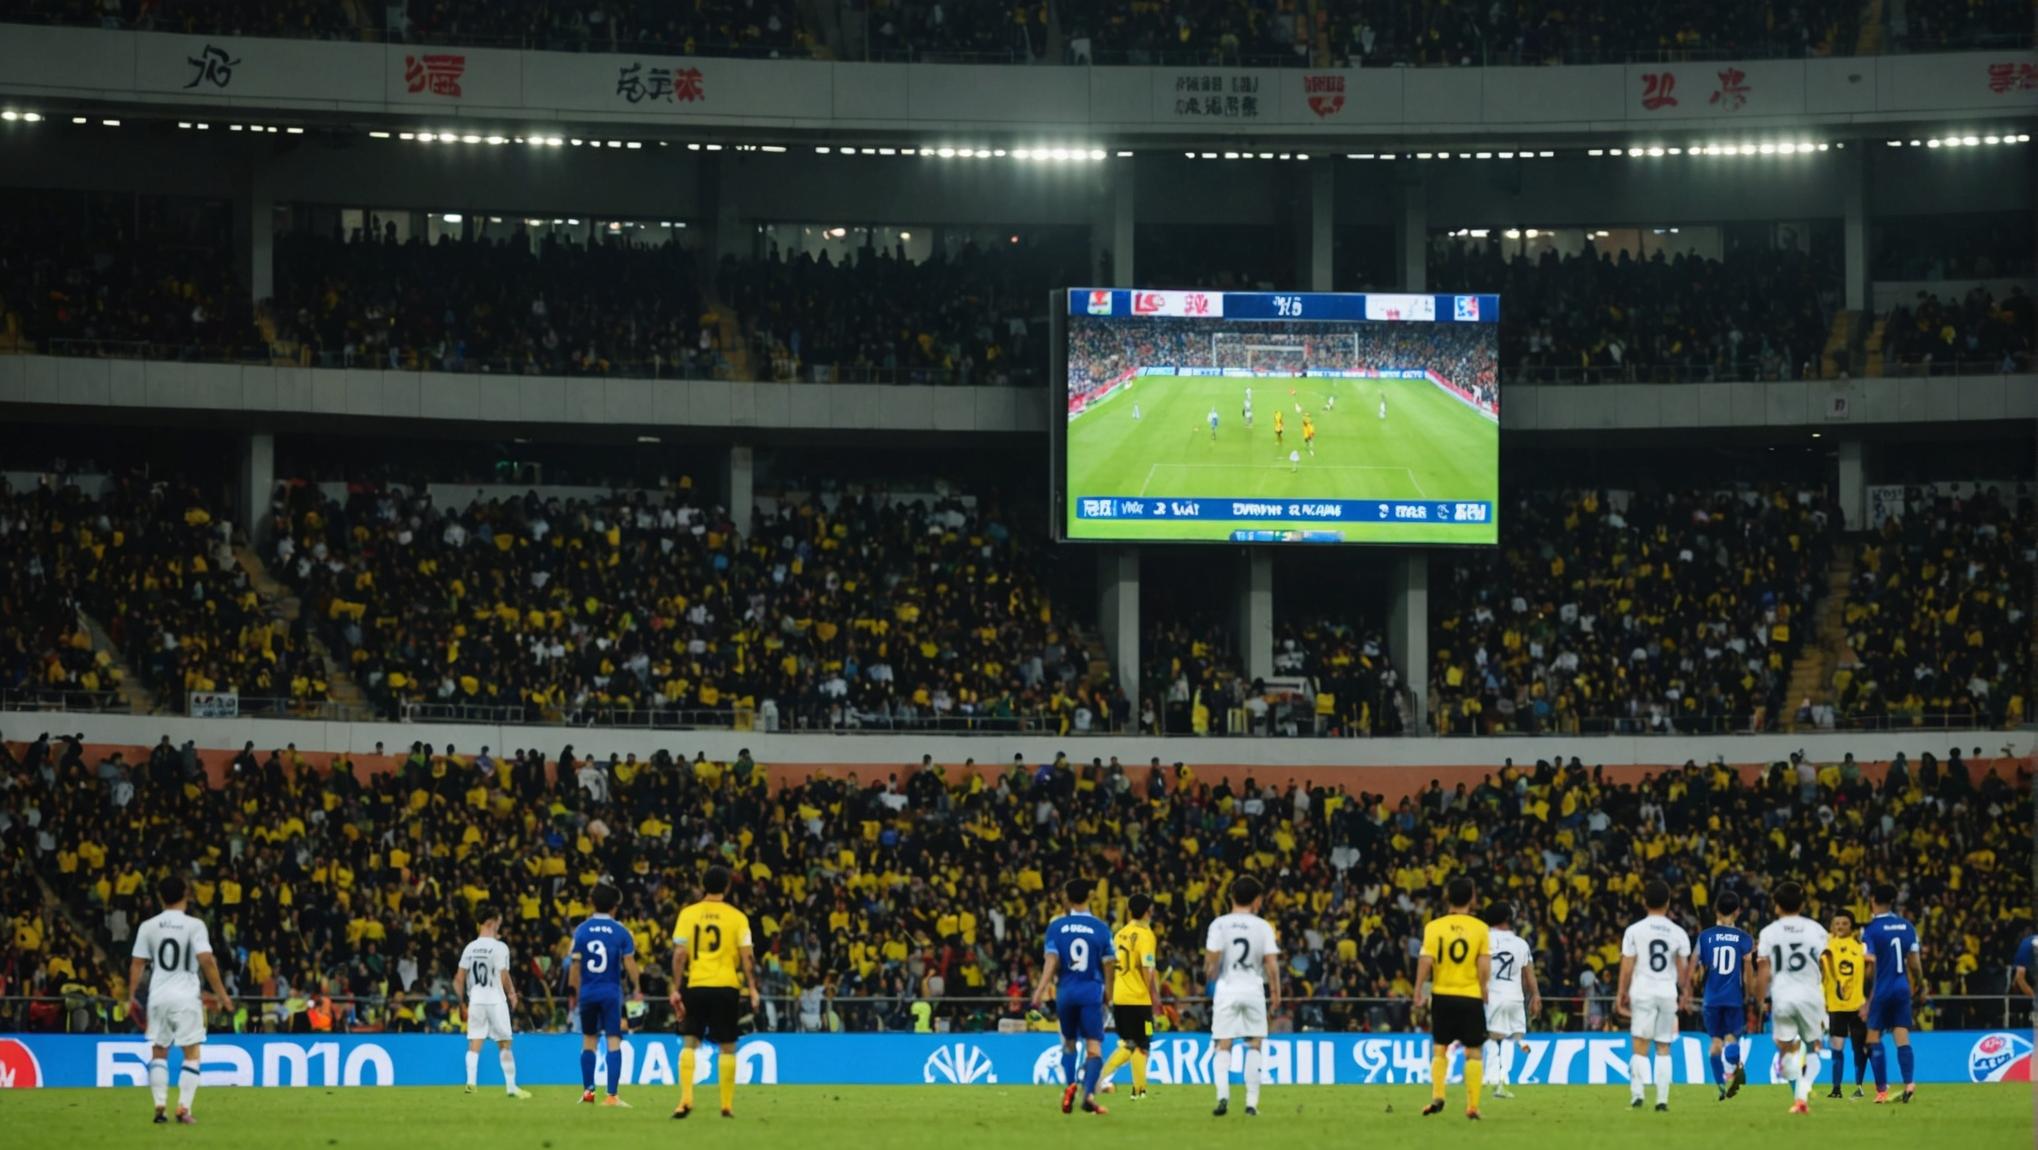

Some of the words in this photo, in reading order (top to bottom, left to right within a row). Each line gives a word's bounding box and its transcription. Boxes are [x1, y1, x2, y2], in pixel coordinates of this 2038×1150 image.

[1232, 937, 1254, 970] 2
[1436, 936, 1469, 965] 10
[1712, 945, 1737, 976] 10
[1889, 936, 1904, 974] 1
